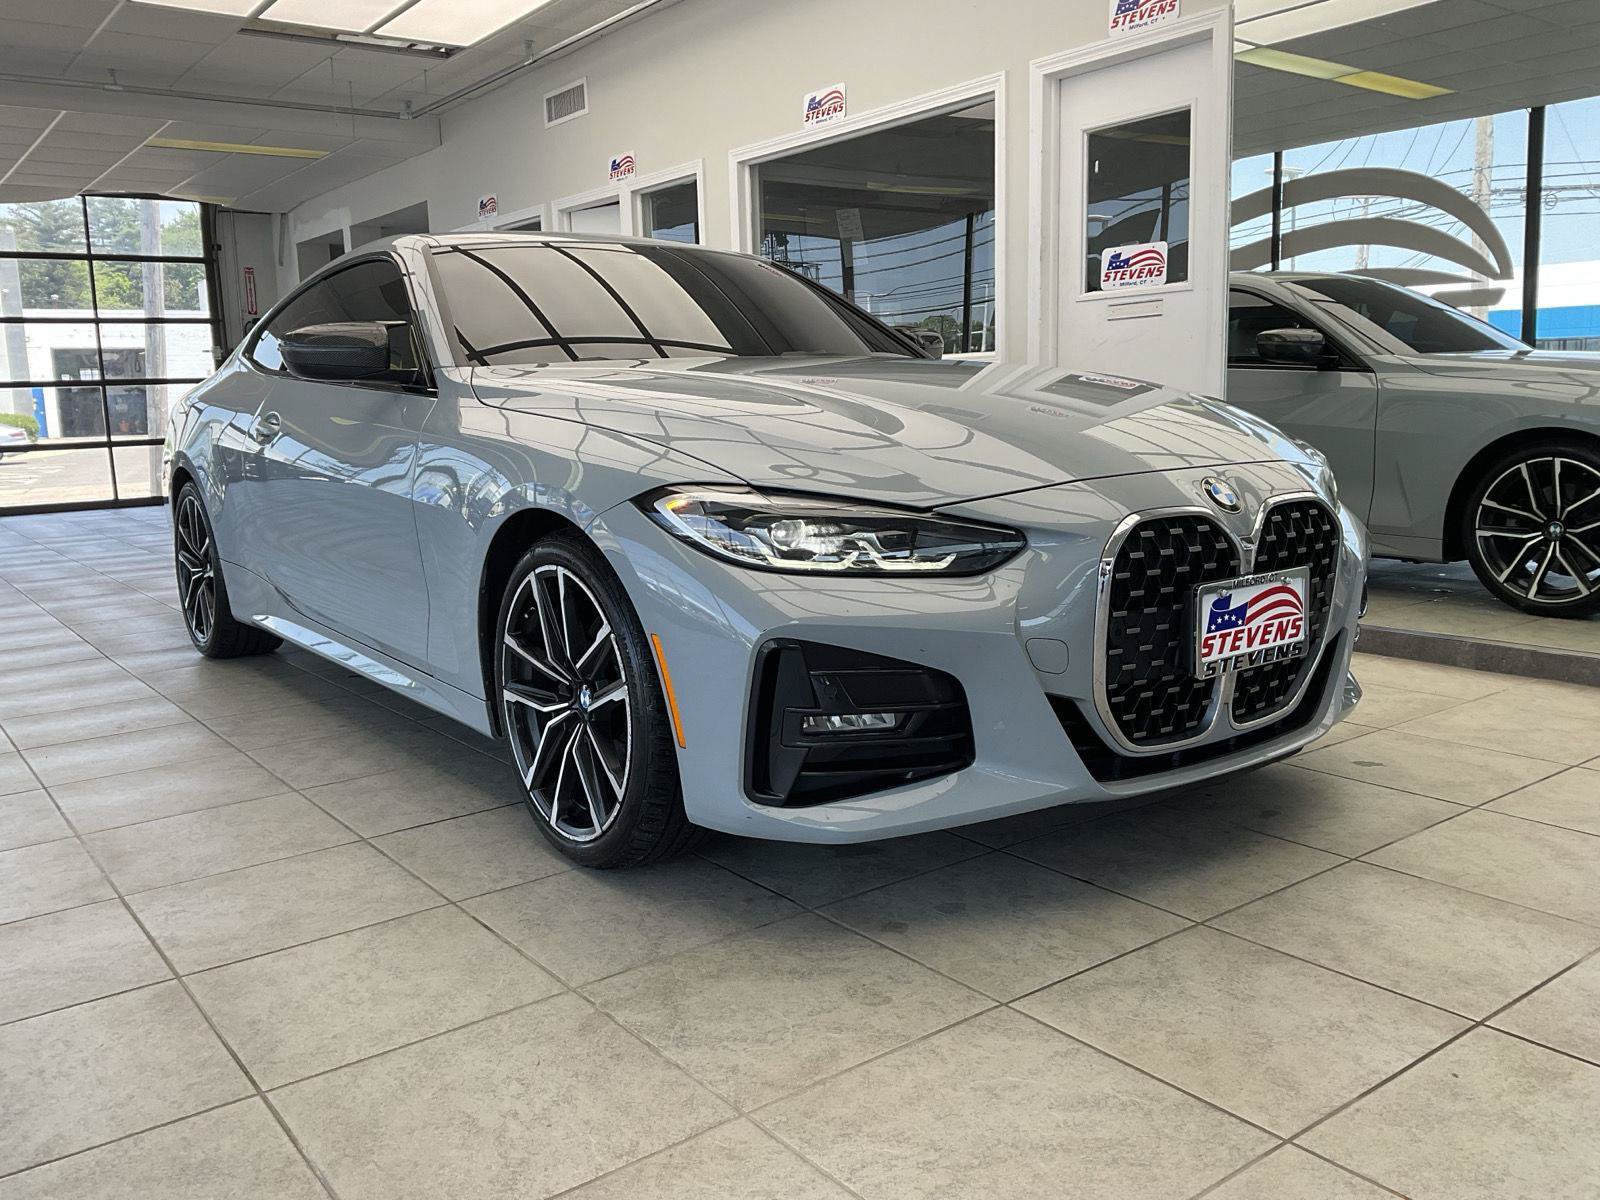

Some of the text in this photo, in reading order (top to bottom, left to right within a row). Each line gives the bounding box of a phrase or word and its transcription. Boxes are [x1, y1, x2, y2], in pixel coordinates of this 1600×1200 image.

[1110, 0, 1178, 29] STEVENS
[804, 102, 844, 122] STEVENS
[609, 165, 635, 180] STEVENS
[1102, 265, 1165, 282] STEVENS
[1201, 617, 1303, 658] STEVENS
[1203, 641, 1303, 678] STEVENS
